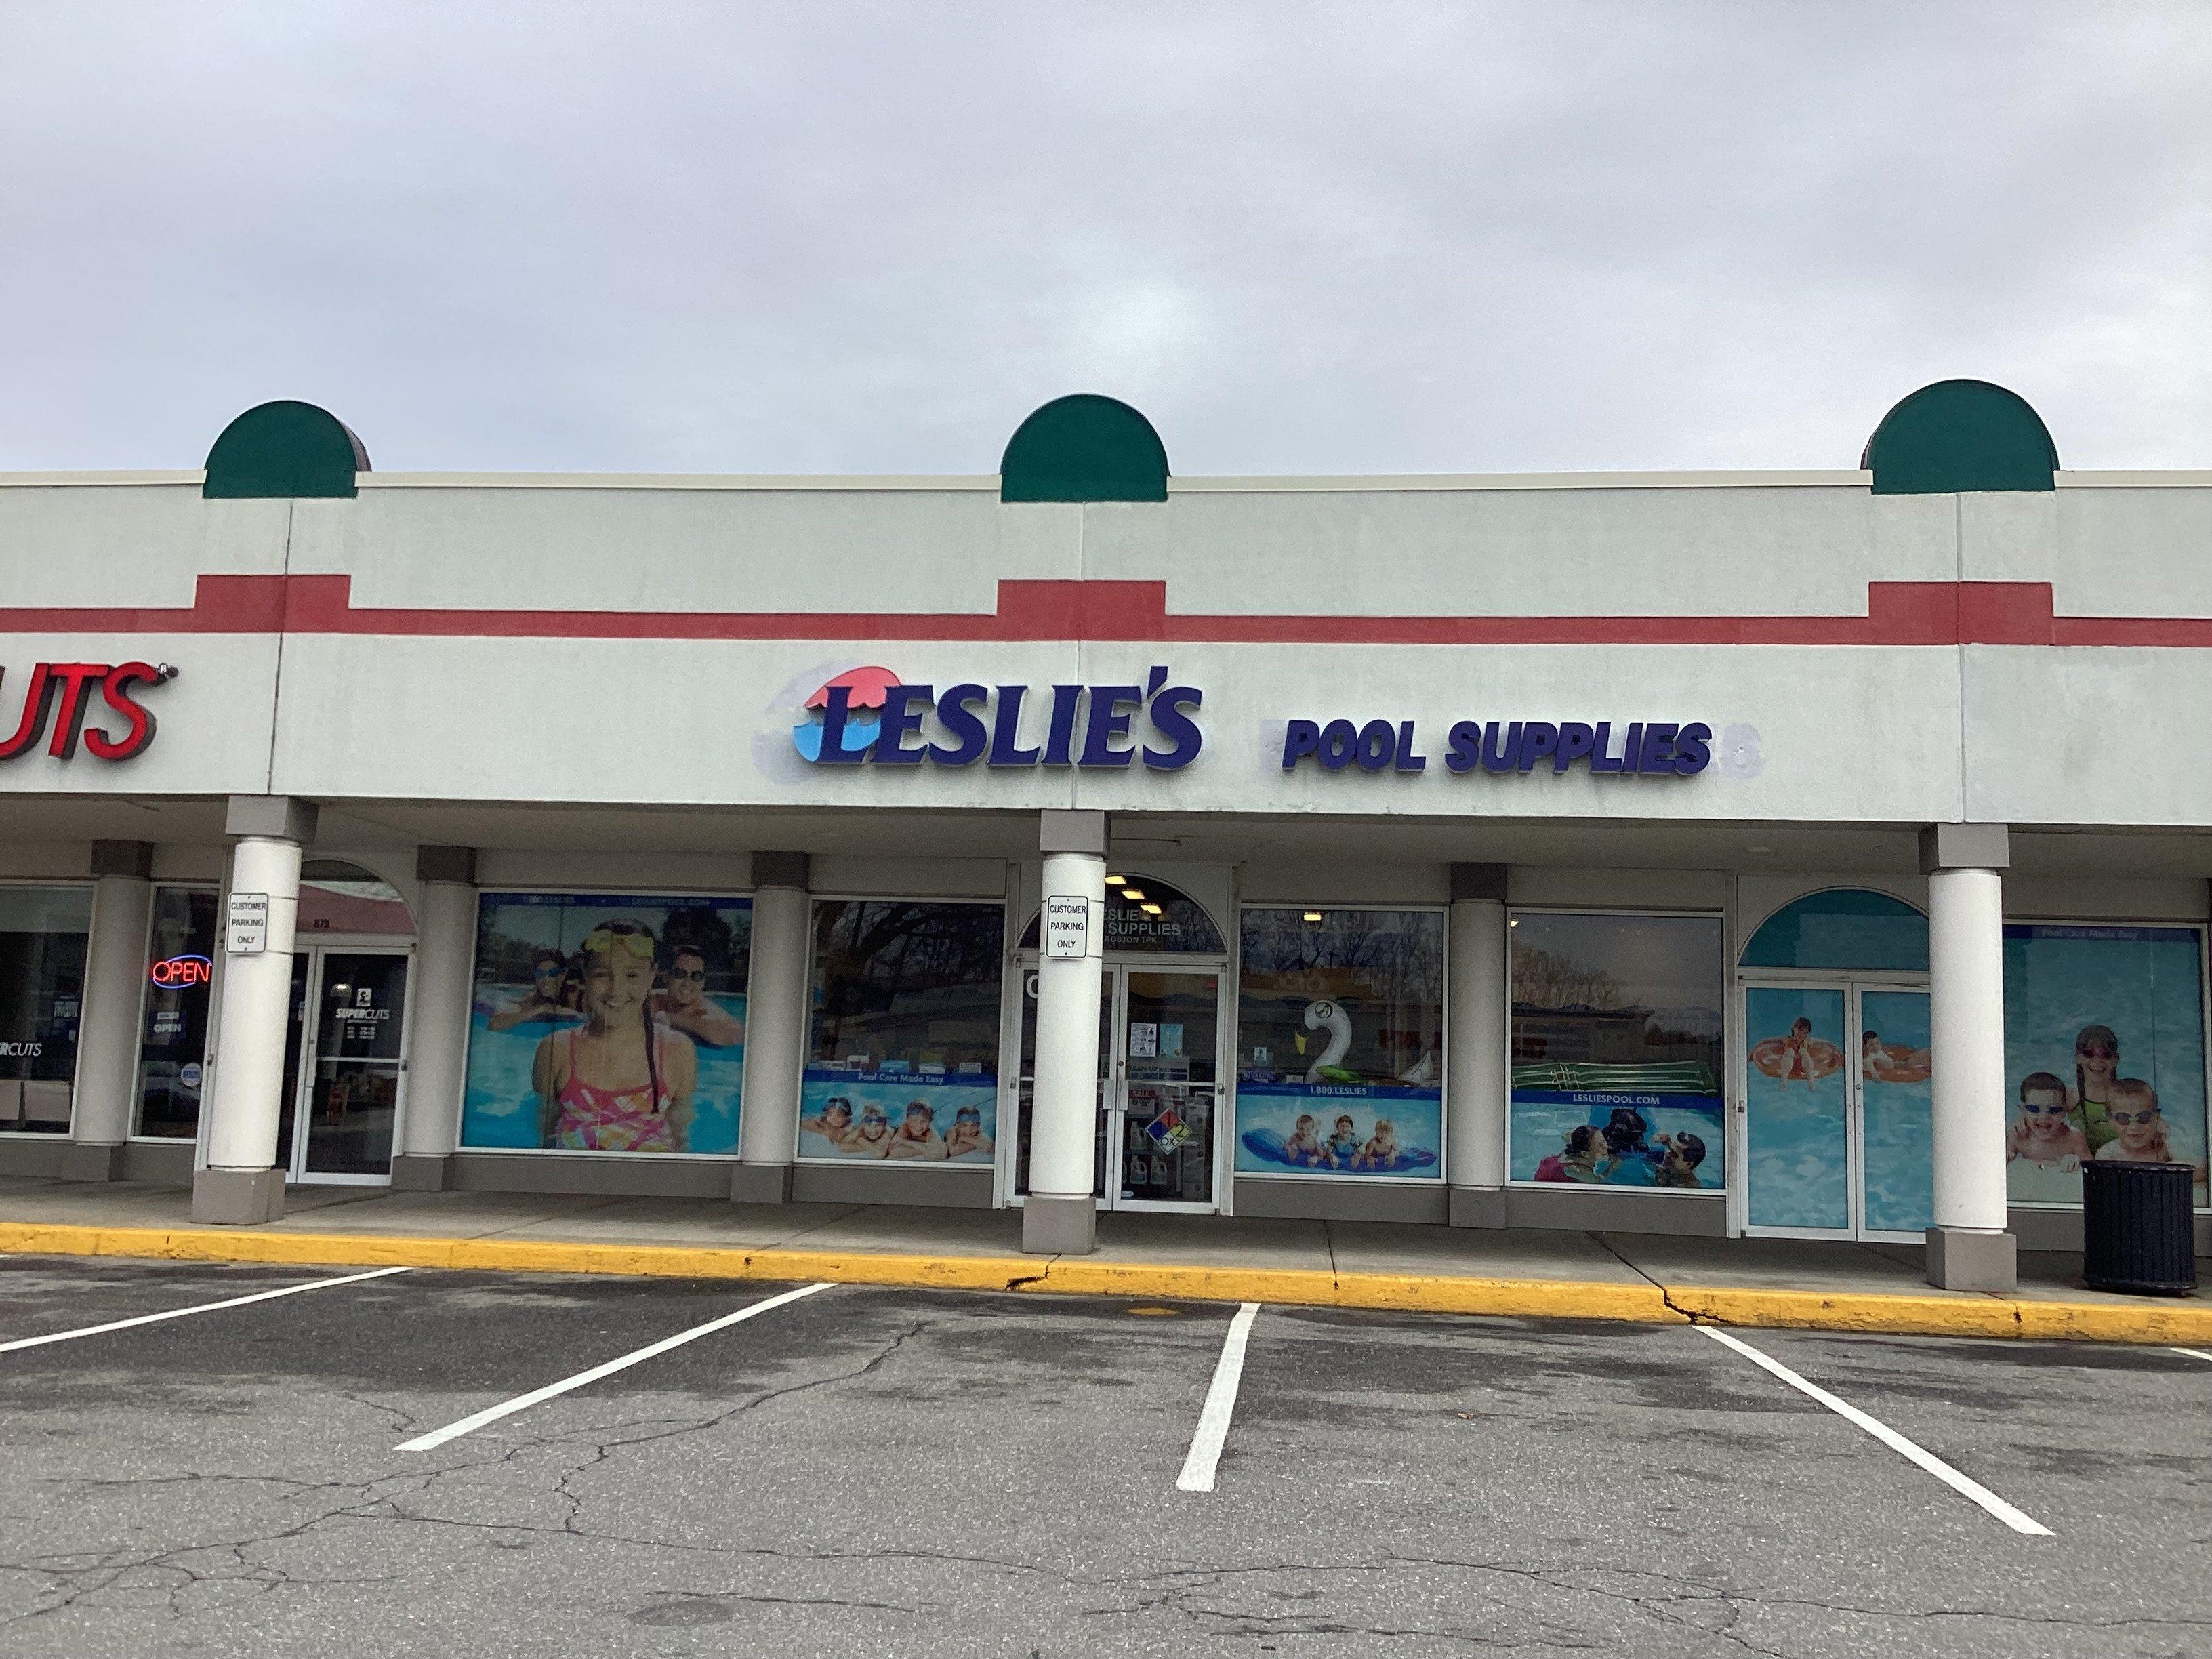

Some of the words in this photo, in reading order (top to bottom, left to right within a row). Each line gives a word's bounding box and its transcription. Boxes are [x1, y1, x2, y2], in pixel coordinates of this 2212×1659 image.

[816, 665, 1203, 769] LESLIE'S
[1282, 719, 1426, 772] POOL
[1445, 721, 1712, 775] SUPPLIES
[231, 902, 266, 910] CUSTOMER
[1050, 905, 1086, 914] CUSTOMER
[232, 918, 263, 926] PARKING
[1050, 922, 1084, 930] PARKING
[1108, 922, 1181, 935] SUPPLIES
[1057, 940, 1076, 948] ONLY
[153, 962, 211, 982] OPEN
[154, 1024, 181, 1033] OPEN
[858, 1073, 876, 1081] Pool
[879, 1073, 899, 1082] Care
[901, 1075, 923, 1083] Made
[926, 1075, 943, 1084] Easy
[1311, 1086, 1367, 1095] 1.800.LESLIES
[1573, 1094, 1660, 1105] LESLIESPOOL.COM
[1160, 1137, 1174, 1146] OX
